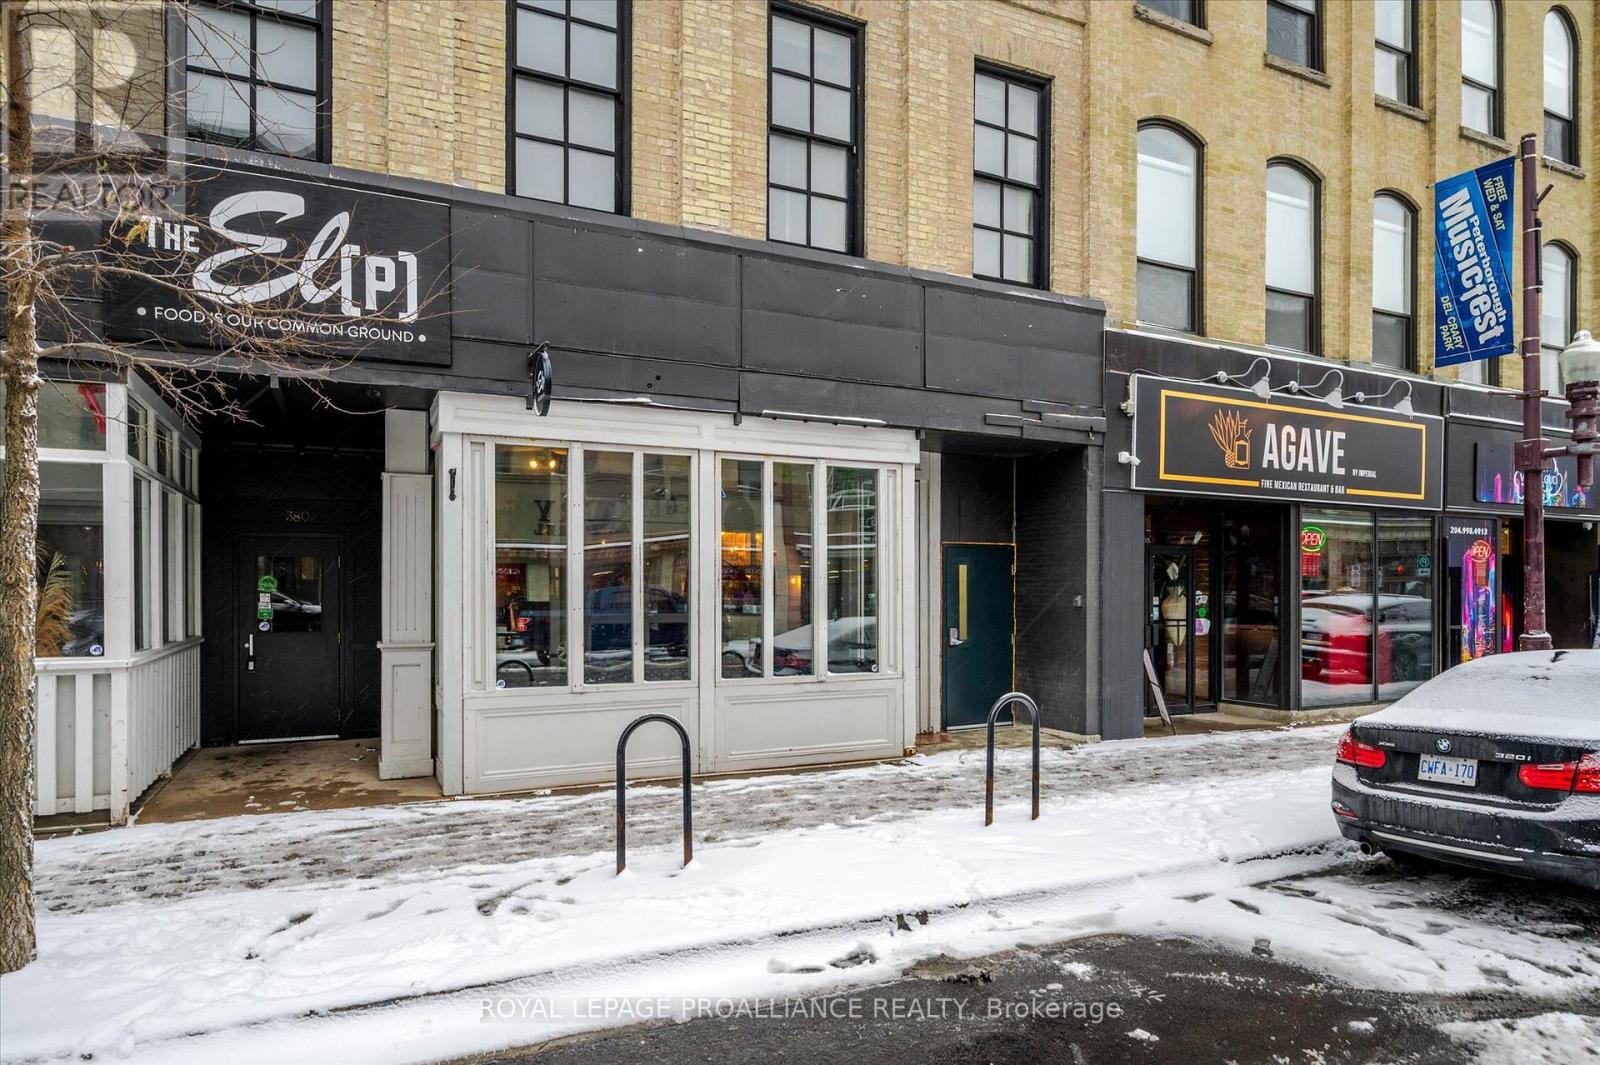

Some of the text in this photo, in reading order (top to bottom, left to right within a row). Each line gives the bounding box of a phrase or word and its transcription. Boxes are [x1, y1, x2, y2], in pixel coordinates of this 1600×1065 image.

[1483, 178, 1506, 231] WED & SAT
[1493, 175, 1508, 203] FREE
[141, 215, 200, 253] THE
[1439, 187, 1505, 345] Musicfest
[1470, 215, 1507, 322] Peterborough
[154, 306, 206, 322] FOOD
[227, 314, 264, 329] OUR
[267, 318, 344, 336] COMMON
[347, 325, 414, 343] GROUND
[1440, 295, 1464, 349] DEL CRARY
[1440, 325, 1455, 351] PARK
[1261, 423, 1346, 475] AGAVE
[1261, 479, 1273, 489] FINE
[1274, 480, 1297, 491] MEXICAN
[1298, 482, 1329, 494] RESTAURANT
[1335, 485, 1345, 495] BAR
[1352, 468, 1358, 477] BY
[1450, 526, 1488, 536] 204.998.4913
[1421, 760, 1474, 779] CWFA 170
